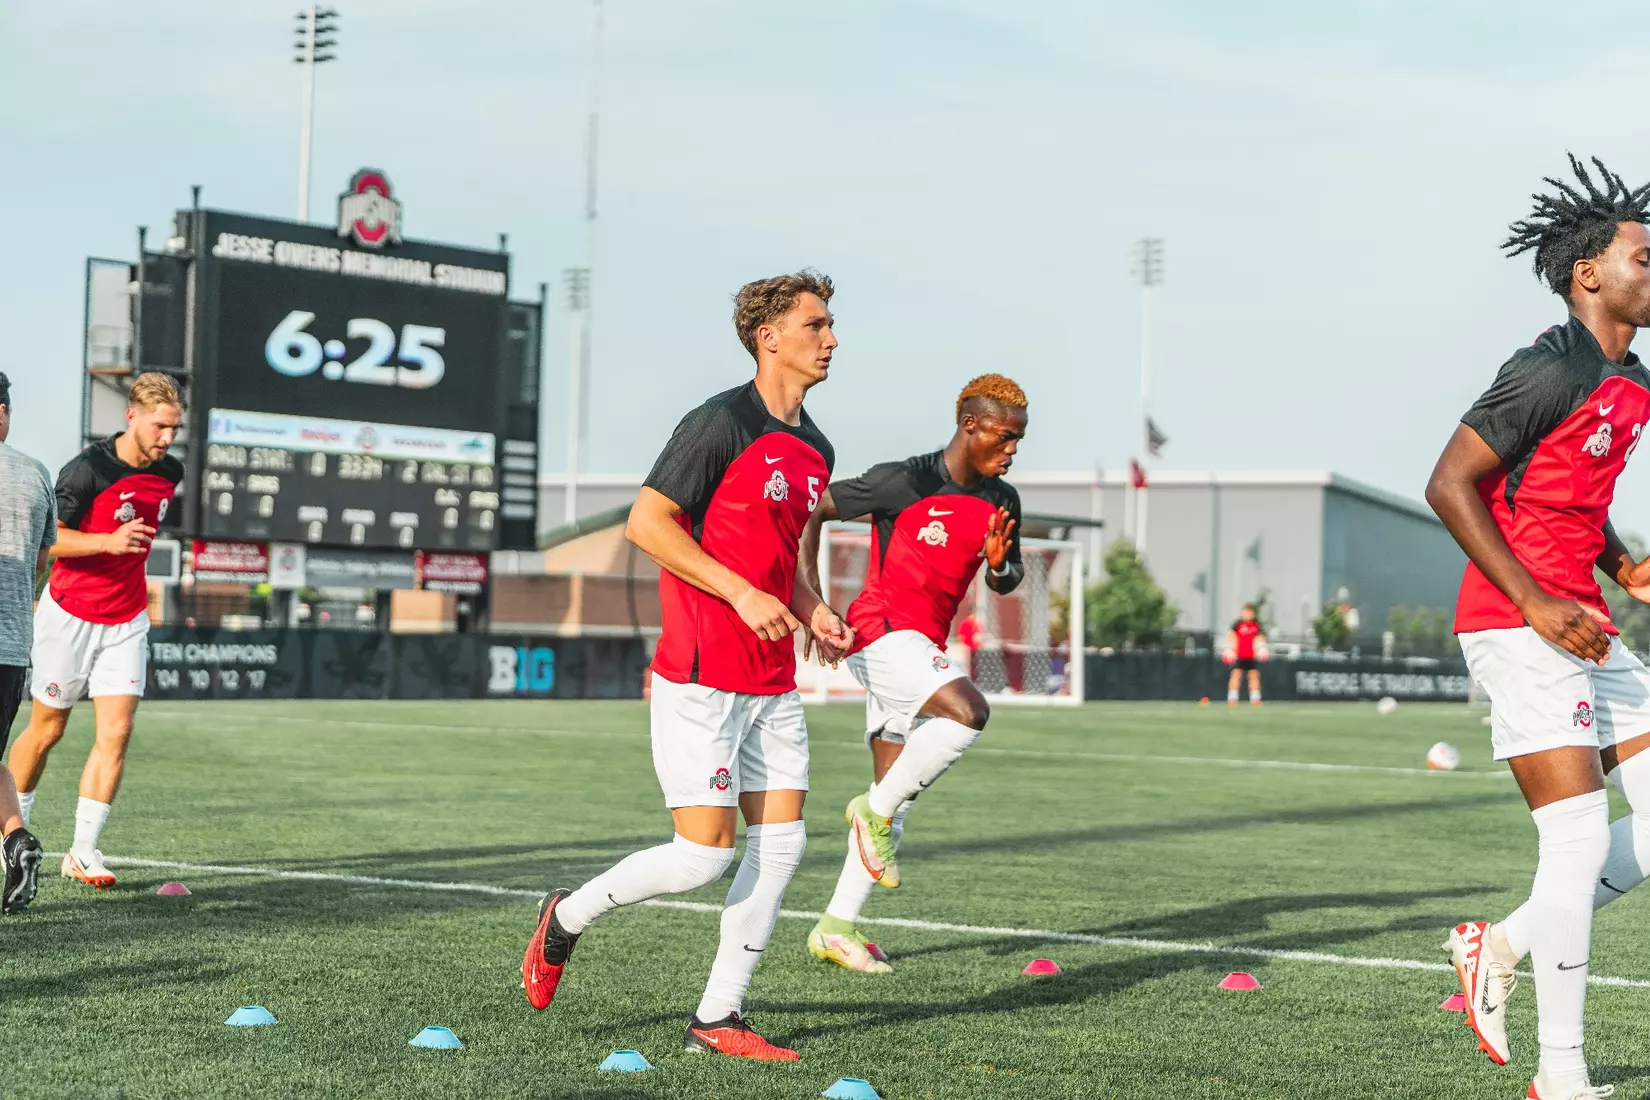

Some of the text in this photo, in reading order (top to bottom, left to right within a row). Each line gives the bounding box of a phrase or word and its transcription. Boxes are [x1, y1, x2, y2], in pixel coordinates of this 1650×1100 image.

[212, 232, 275, 264] JESSE
[274, 240, 341, 273] OWENS
[340, 249, 432, 286] MEMORIAL
[265, 310, 446, 389] 6:25
[157, 498, 169, 522] 8
[807, 475, 819, 512] 5
[153, 643, 184, 664] TEN
[184, 643, 277, 665] CHAMPIONS
